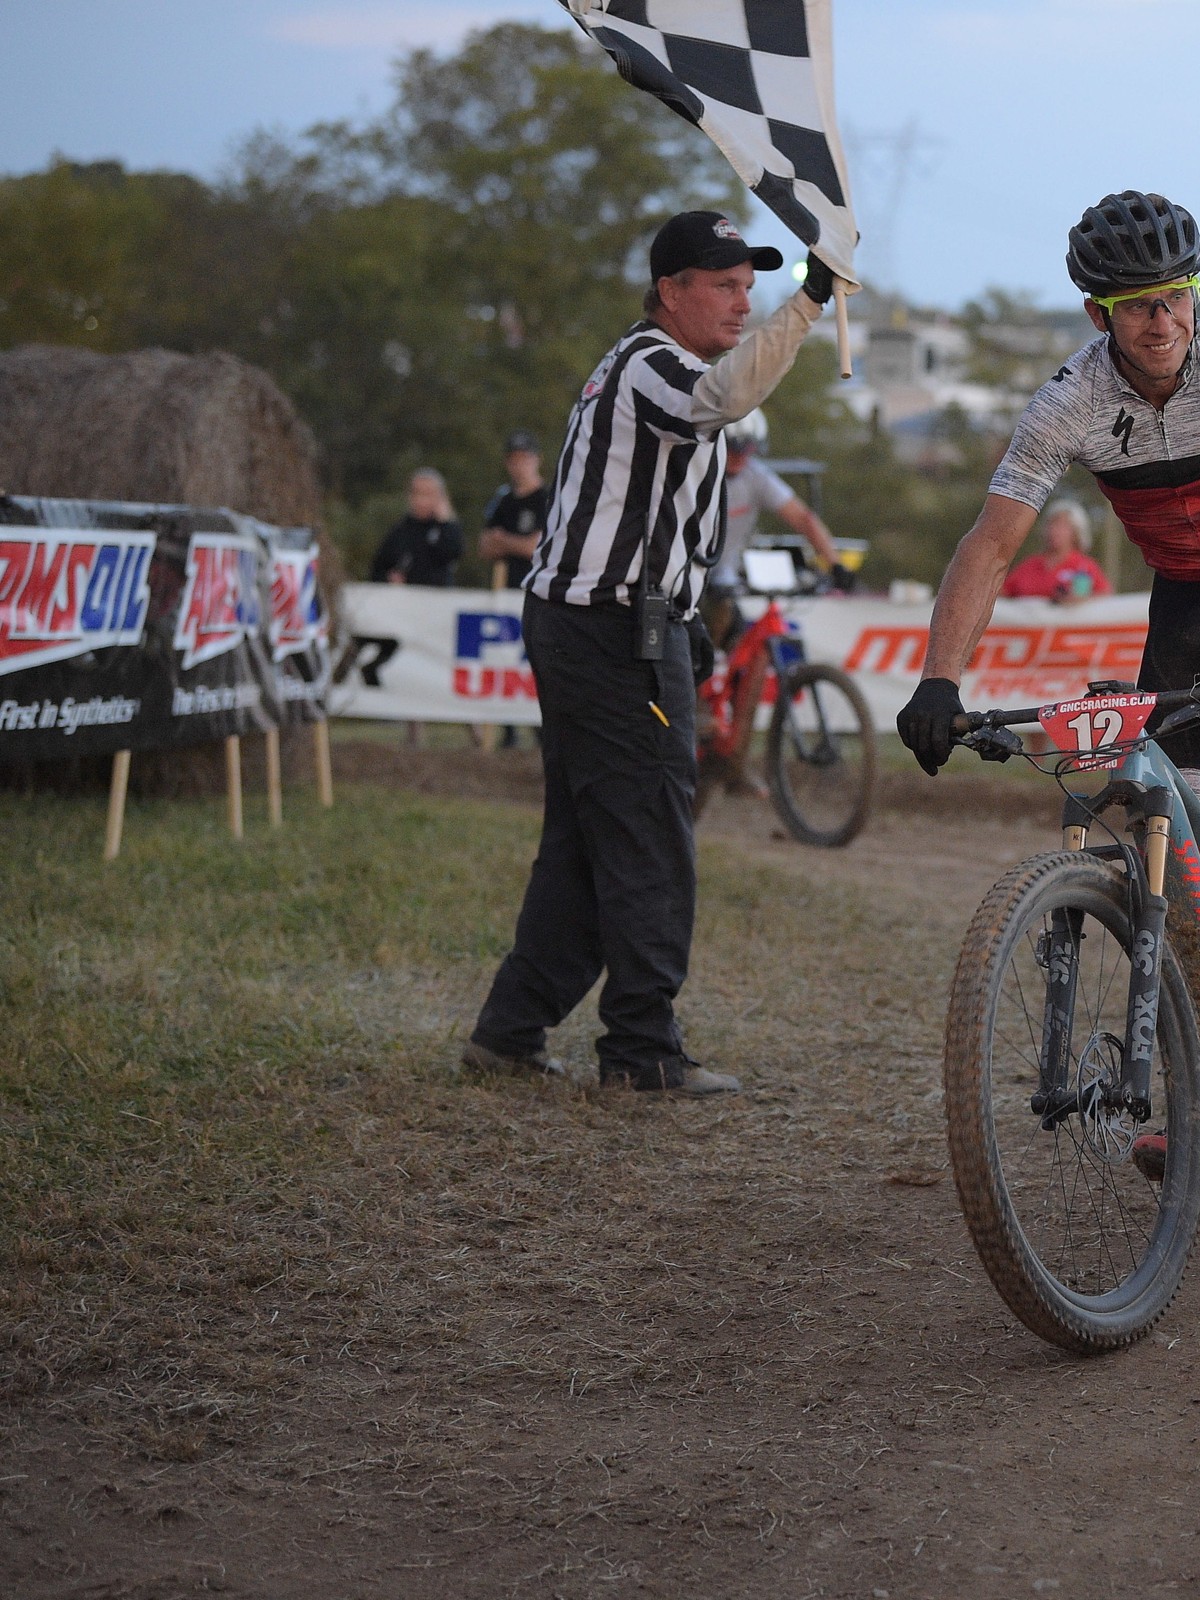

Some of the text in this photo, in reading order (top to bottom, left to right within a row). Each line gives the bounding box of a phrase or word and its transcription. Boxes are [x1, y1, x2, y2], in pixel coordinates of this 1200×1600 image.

[456, 612, 529, 660] P
[648, 628, 658, 646] 3
[842, 624, 1148, 671] MOSE
[1060, 695, 1156, 713] GNCCRACING.COM
[1067, 709, 1124, 760] 12
[1131, 989, 1156, 1061] FOX
